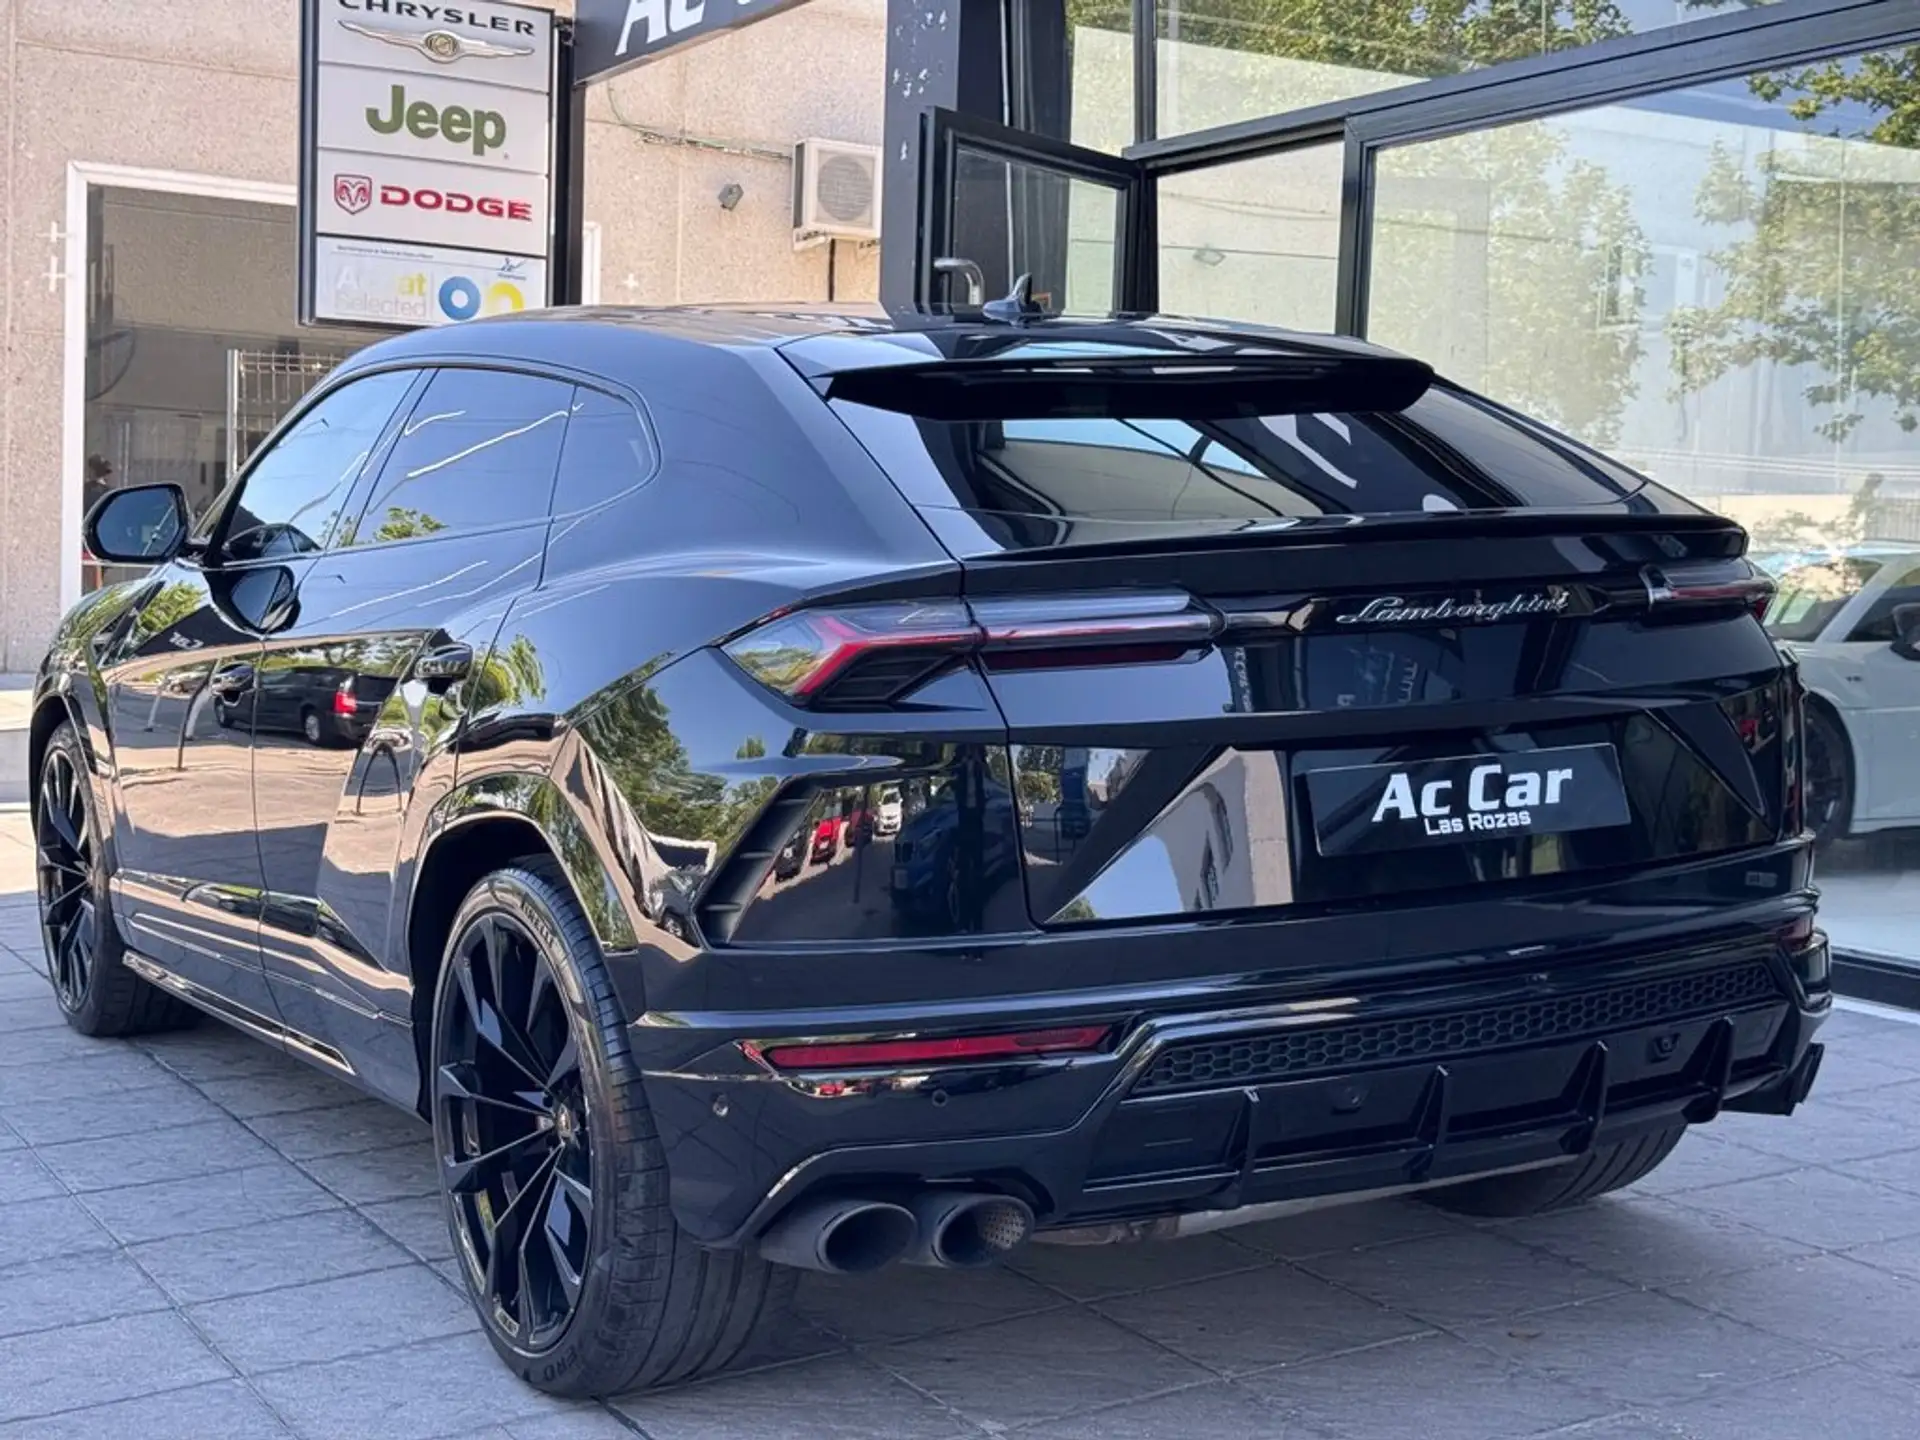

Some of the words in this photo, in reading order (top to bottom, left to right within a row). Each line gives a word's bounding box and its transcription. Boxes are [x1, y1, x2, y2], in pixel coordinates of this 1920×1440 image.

[339, 0, 535, 36] CHRYSLER
[365, 84, 506, 156] Jeep
[380, 184, 533, 221] DODGE
[1336, 591, 1569, 624] Lamborghini
[1371, 772, 1452, 822] Ac
[1468, 764, 1573, 812] Car
[1424, 817, 1463, 836] Las
[1467, 810, 1531, 832] Rozas
